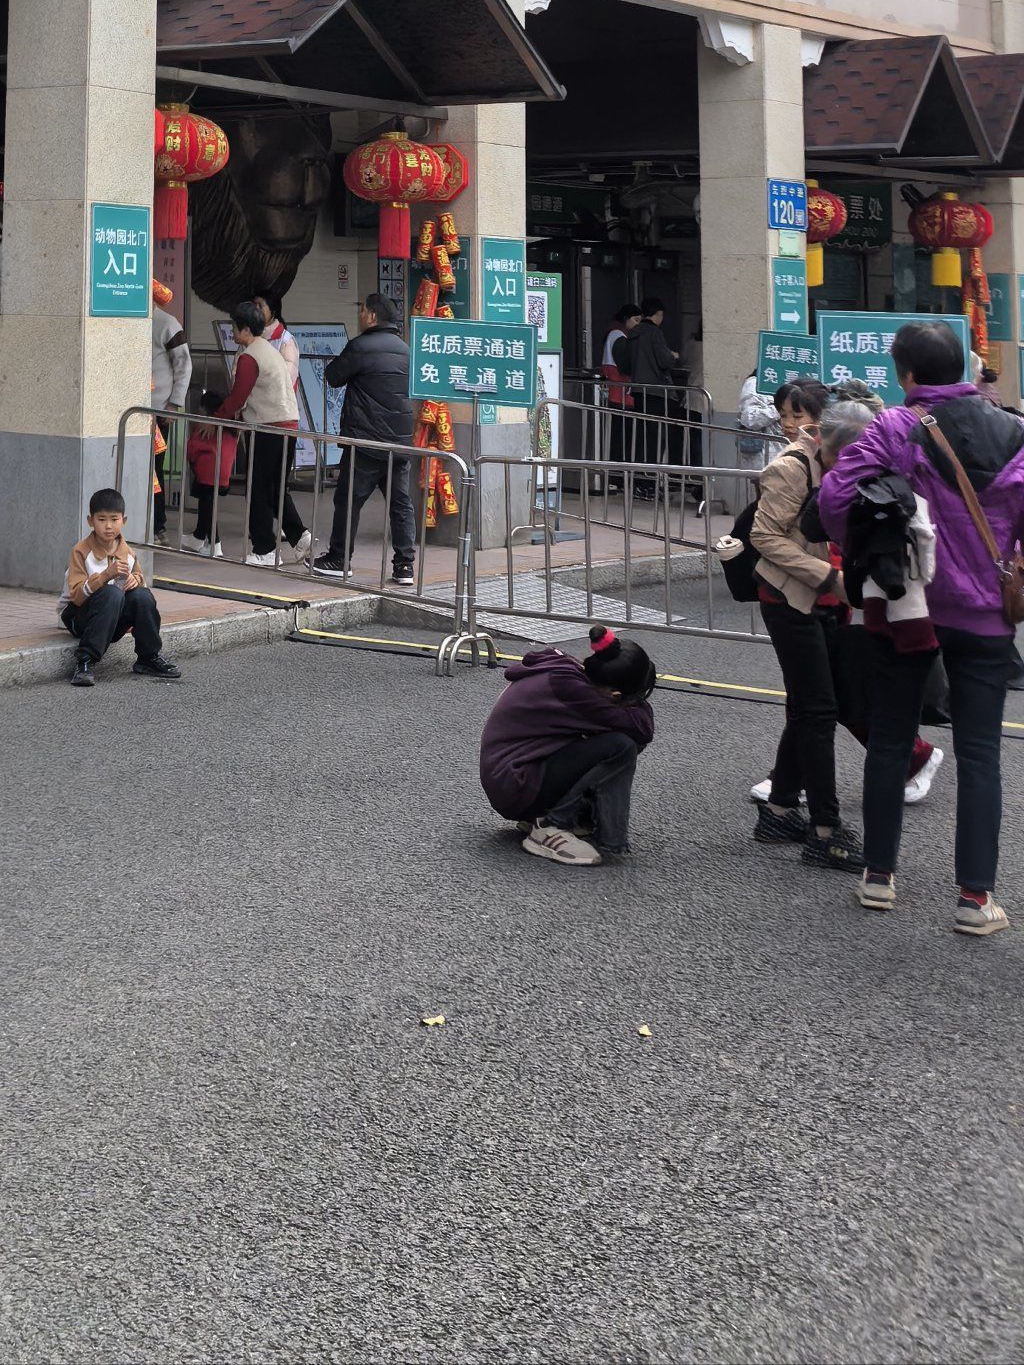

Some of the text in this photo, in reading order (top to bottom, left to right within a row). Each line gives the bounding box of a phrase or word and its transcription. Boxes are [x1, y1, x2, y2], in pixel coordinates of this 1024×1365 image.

[773, 199, 794, 225] 120
[840, 194, 884, 222] 票处
[95, 228, 147, 247] 动物园北门
[103, 248, 137, 275] 入口
[485, 258, 523, 272] 动物园北门
[492, 275, 516, 296] 入口
[421, 333, 526, 360] 纸质票通道
[420, 363, 526, 390] 免票通道
[830, 364, 902, 388] 免票
